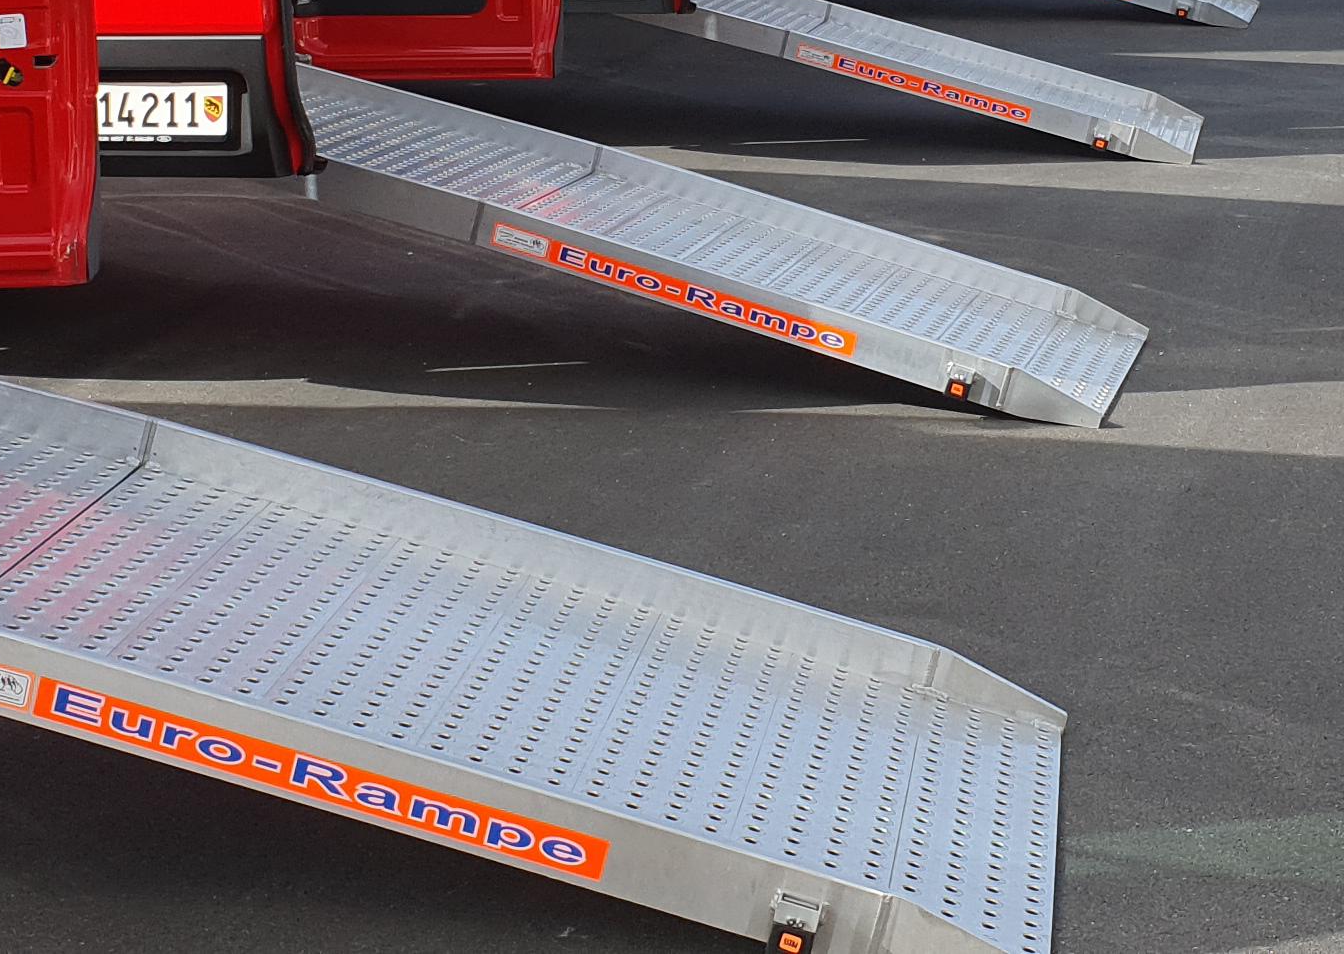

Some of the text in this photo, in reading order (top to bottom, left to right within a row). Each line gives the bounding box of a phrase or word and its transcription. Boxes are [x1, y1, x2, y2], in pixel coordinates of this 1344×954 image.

[837, 56, 1028, 121] Euro-Rampe
[558, 246, 846, 349] Euro-Rampe
[53, 686, 587, 867] Euro-Rampe
